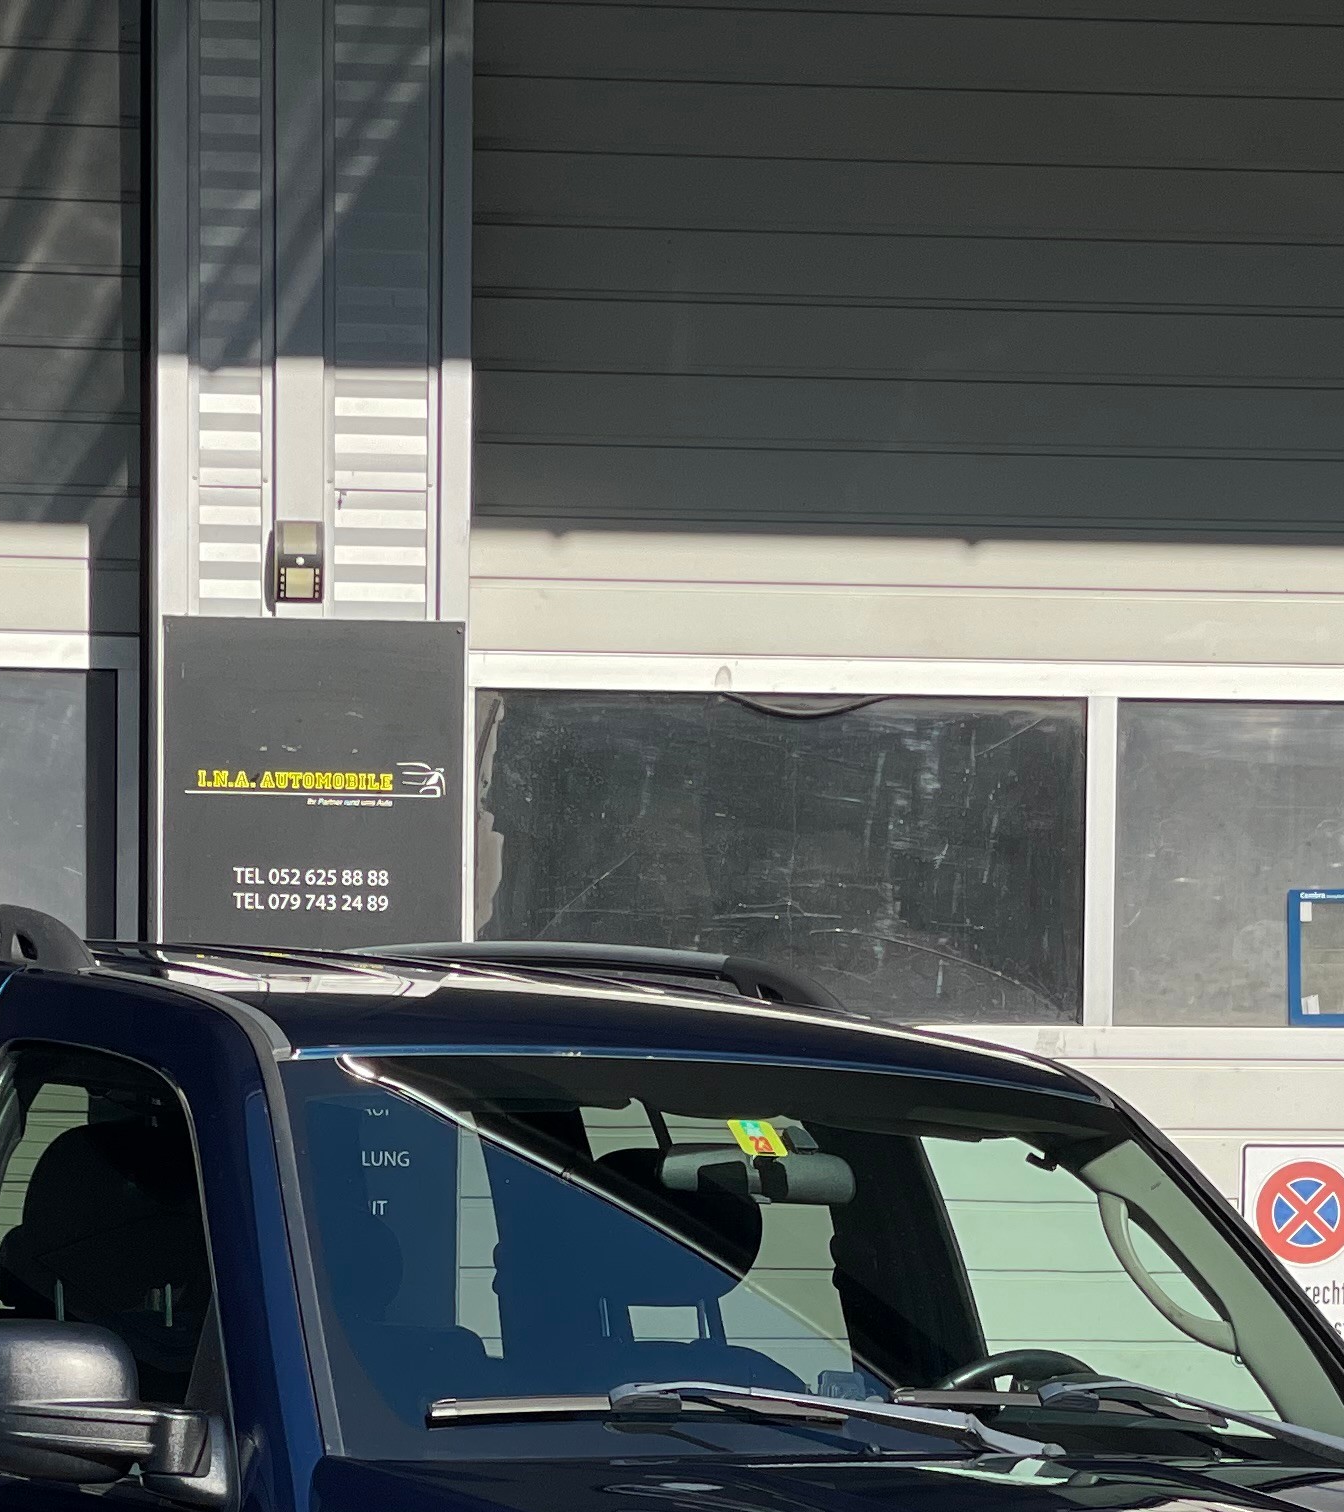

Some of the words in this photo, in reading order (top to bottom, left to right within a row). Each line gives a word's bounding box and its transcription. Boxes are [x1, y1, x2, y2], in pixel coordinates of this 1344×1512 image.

[197, 770, 257, 789] I.N.A.
[260, 771, 394, 792] AUTOMOBILE
[232, 867, 265, 885] TEL
[268, 868, 301, 886] 052
[305, 869, 338, 887] 625
[341, 870, 364, 887] 88
[367, 870, 390, 887] 88
[232, 892, 265, 910] TEL
[268, 893, 301, 910] 079
[305, 894, 338, 911] 743
[341, 894, 363, 911] 24
[367, 895, 390, 912] 89
[368, 1200, 388, 1216] IT
